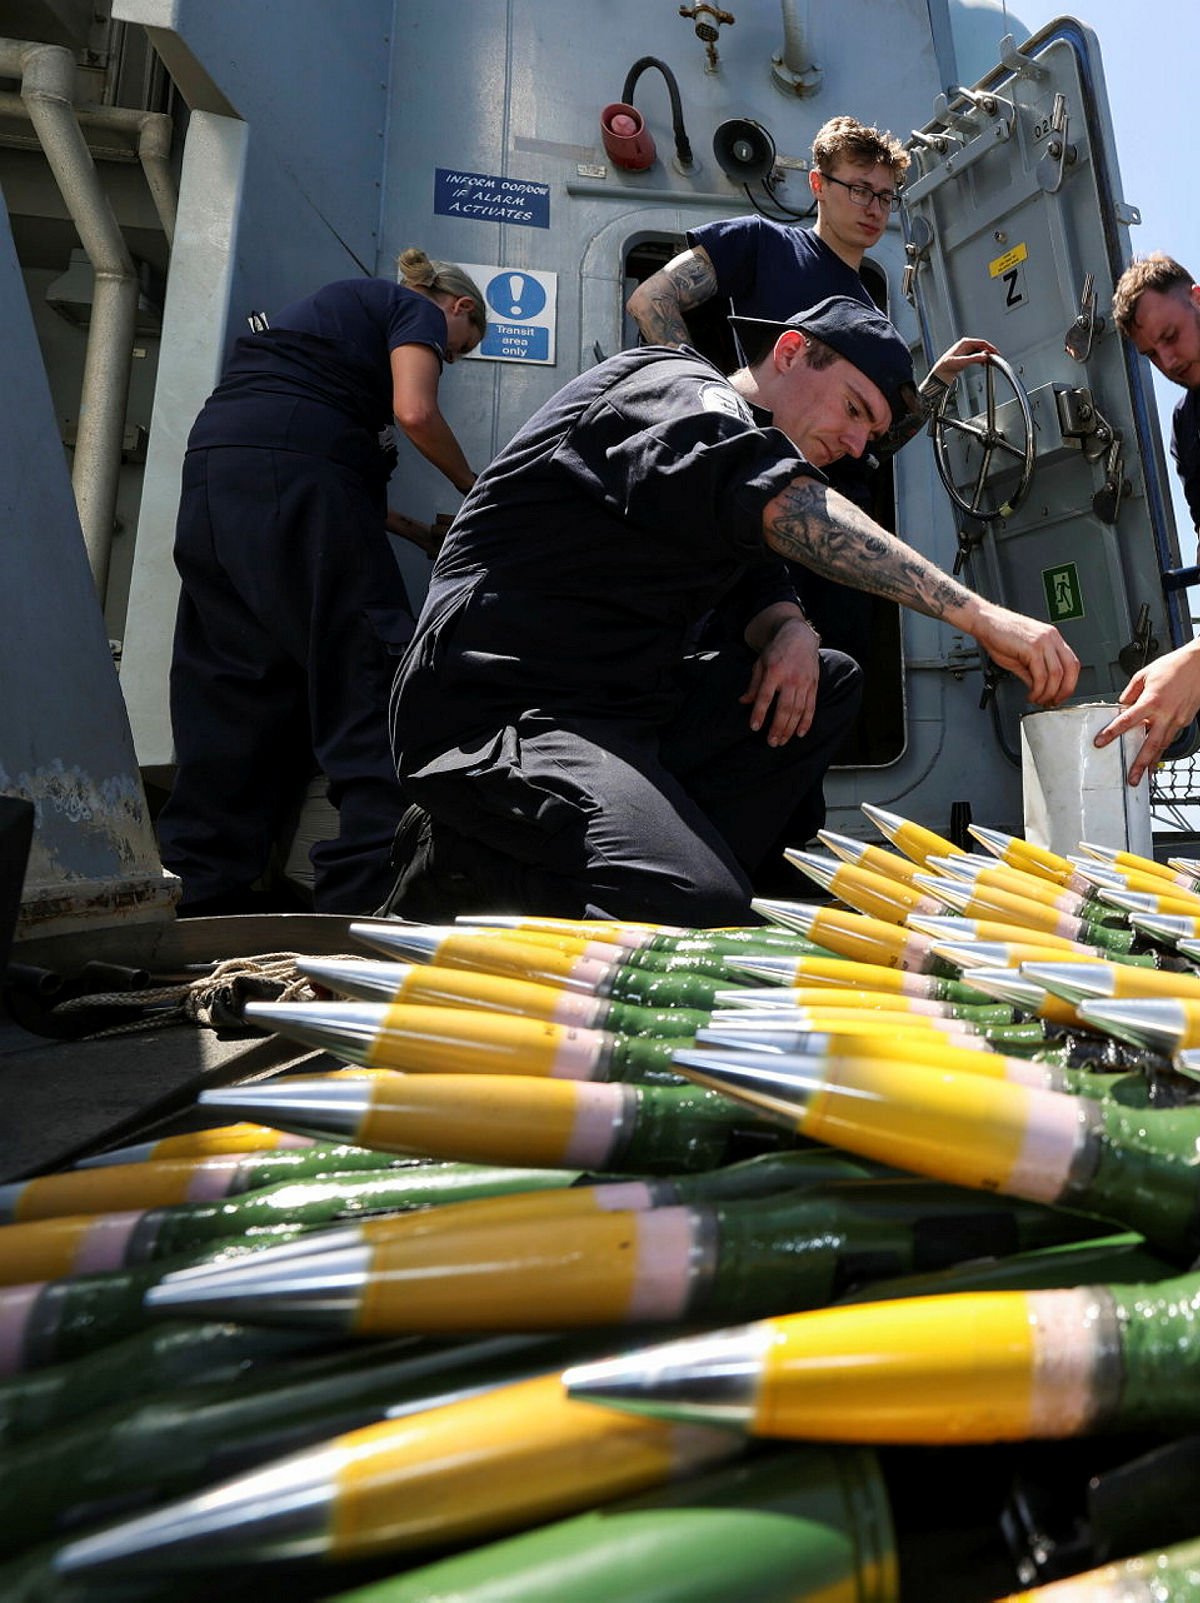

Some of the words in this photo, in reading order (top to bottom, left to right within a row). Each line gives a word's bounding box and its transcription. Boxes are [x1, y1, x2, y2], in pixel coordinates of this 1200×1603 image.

[445, 174, 496, 188] INFORM
[452, 189, 468, 197] IF
[472, 192, 526, 206] ALARM
[448, 202, 533, 221] ACTIVATES
[1003, 268, 1023, 307] Z
[495, 324, 535, 336] Transit
[502, 337, 529, 346] area
[502, 347, 528, 357] only
